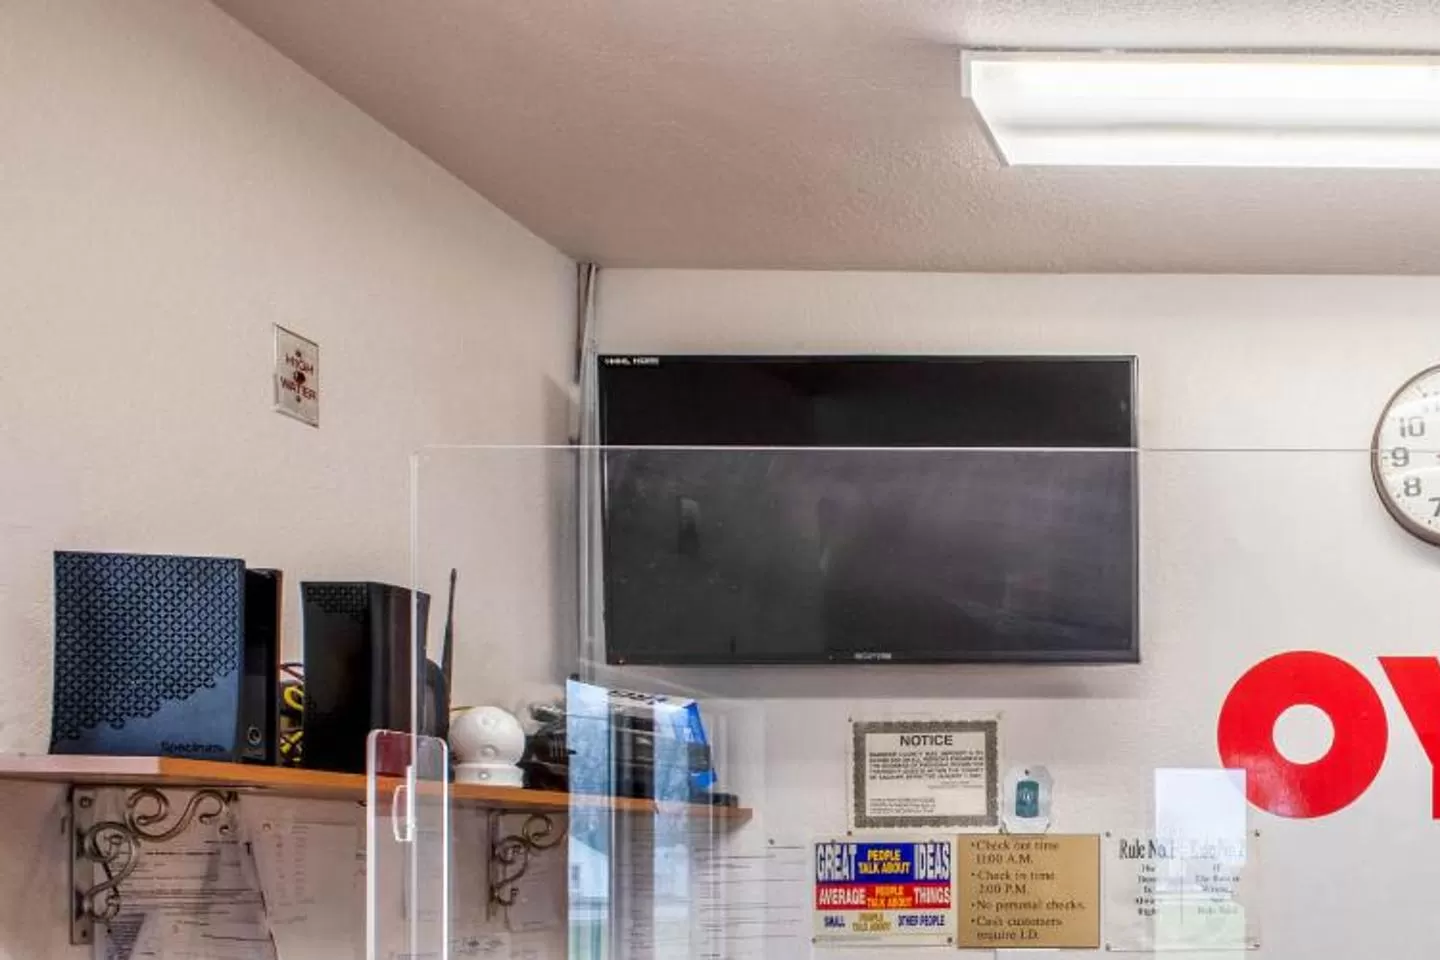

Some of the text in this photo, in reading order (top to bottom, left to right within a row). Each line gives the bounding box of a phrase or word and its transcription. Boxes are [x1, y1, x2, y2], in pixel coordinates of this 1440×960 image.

[1400, 416, 1425, 437] 10
[1391, 447, 1409, 467] 9
[1403, 477, 1422, 497] 8
[900, 735, 953, 746] NOTICE
[977, 840, 1059, 850] Check out time
[1119, 838, 1146, 859] Rule
[817, 843, 951, 881] GREAT PEOPLE IDEAS
[1007, 854, 1034, 864] A.M.
[858, 862, 911, 874] TALK ABOUT
[978, 870, 1010, 880] Check
[820, 888, 866, 905] AVERAGE
[913, 887, 951, 904] THINGS
[977, 900, 993, 909] No
[996, 899, 1041, 912] personal
